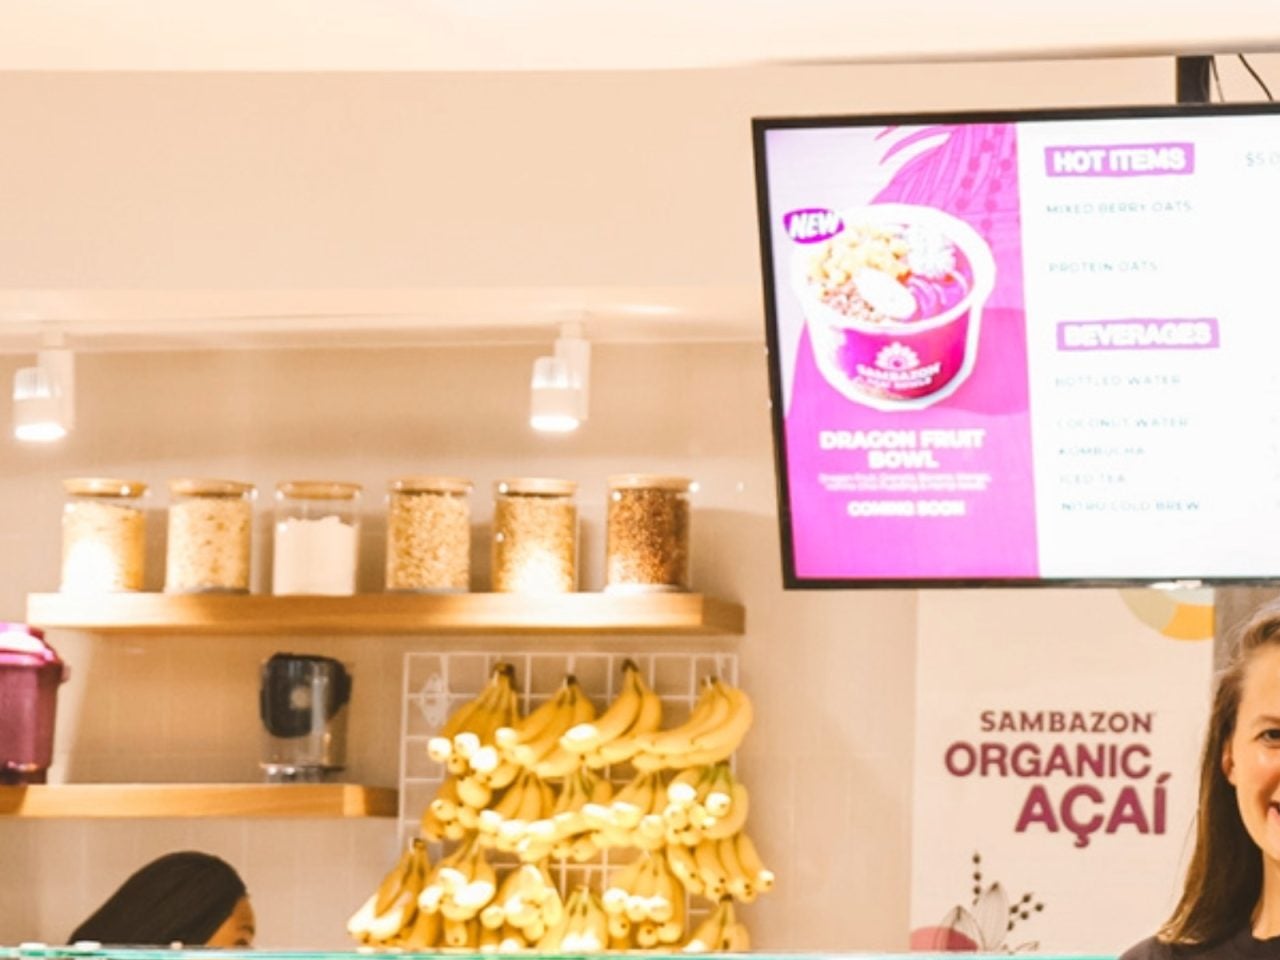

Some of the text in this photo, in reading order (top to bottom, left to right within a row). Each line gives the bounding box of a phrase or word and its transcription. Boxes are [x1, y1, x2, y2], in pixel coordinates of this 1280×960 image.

[1053, 146, 1187, 174] HOT ITEMS
[1046, 200, 1192, 214] MIXED BERRY OATS
[790, 213, 837, 237] NEW
[1048, 260, 1159, 272] PROTEIN OATS
[1065, 323, 1210, 346] BEVERAGES
[1128, 374, 1182, 386] WATER
[820, 429, 985, 449] DRAGON FRUIT
[869, 450, 939, 468] BOWL
[847, 499, 966, 517] COMING SOON
[980, 710, 1152, 733] SAMBAZON
[944, 741, 1152, 779] ORGANIC
[1014, 772, 1172, 849] AÇAÍ
